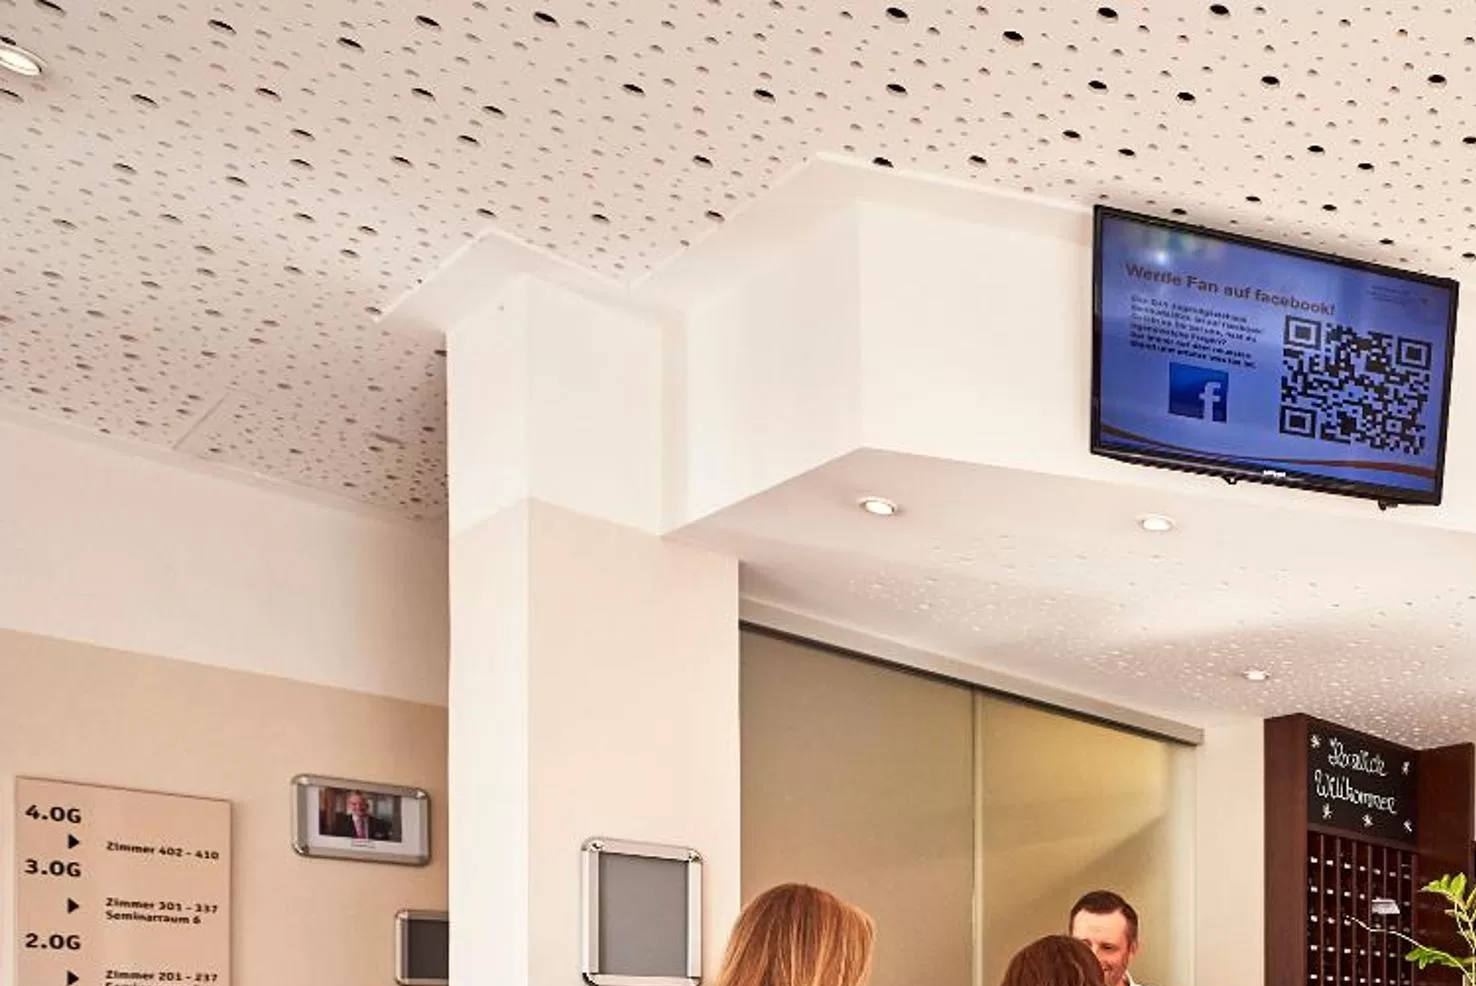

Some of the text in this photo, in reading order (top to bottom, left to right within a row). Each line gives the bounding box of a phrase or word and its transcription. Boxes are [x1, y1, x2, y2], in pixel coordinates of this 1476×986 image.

[1125, 263, 1336, 316] Werde Fan auf facebook!
[25, 804, 82, 824] 4.OG
[106, 841, 155, 854] Zimmer
[159, 846, 183, 858] 402
[195, 850, 220, 861] 410
[24, 859, 82, 878] 3.OG
[106, 898, 154, 909] Zimmer
[158, 901, 182, 912] 301
[105, 910, 190, 924] Seminarraum
[25, 933, 82, 950] 2.OG
[105, 970, 154, 980] Zimmer
[158, 972, 182, 981] 201
